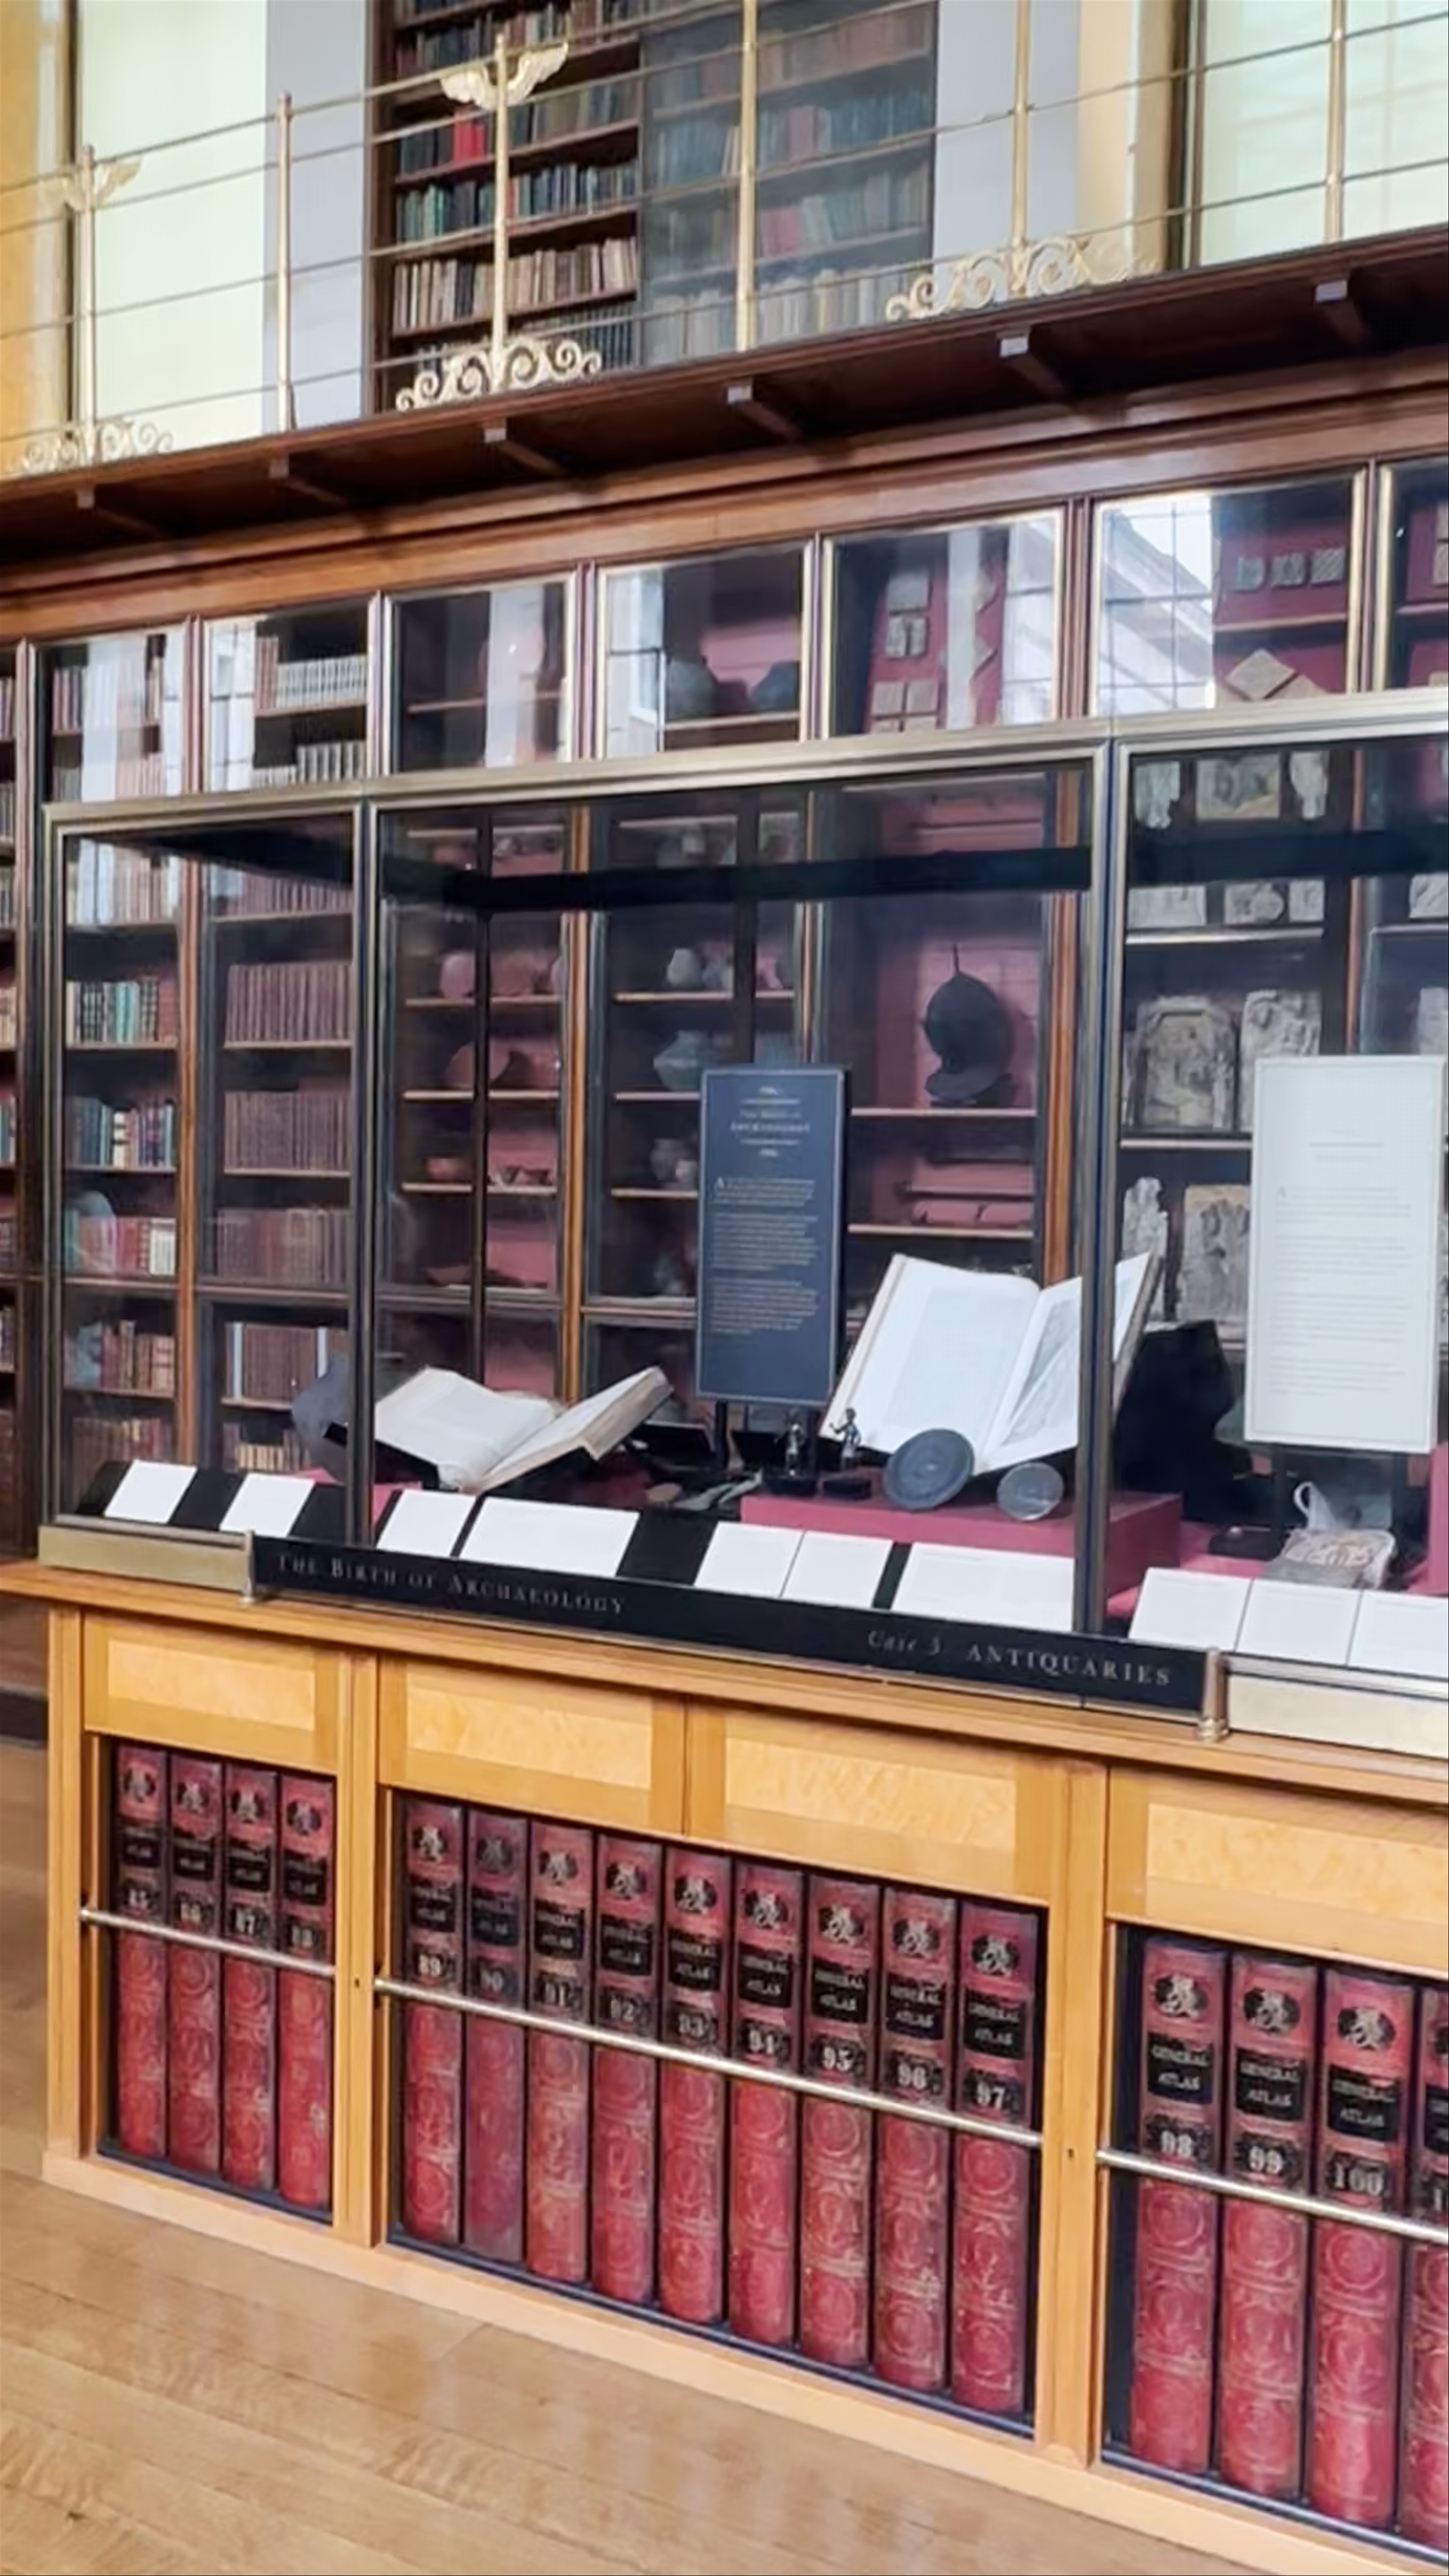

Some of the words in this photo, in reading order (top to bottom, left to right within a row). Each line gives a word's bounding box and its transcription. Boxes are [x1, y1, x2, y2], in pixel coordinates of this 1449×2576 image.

[968, 1642, 1170, 1686] ANTIQUARIES
[822, 2045, 853, 2072] 95
[1334, 2161, 1384, 2197] 100
